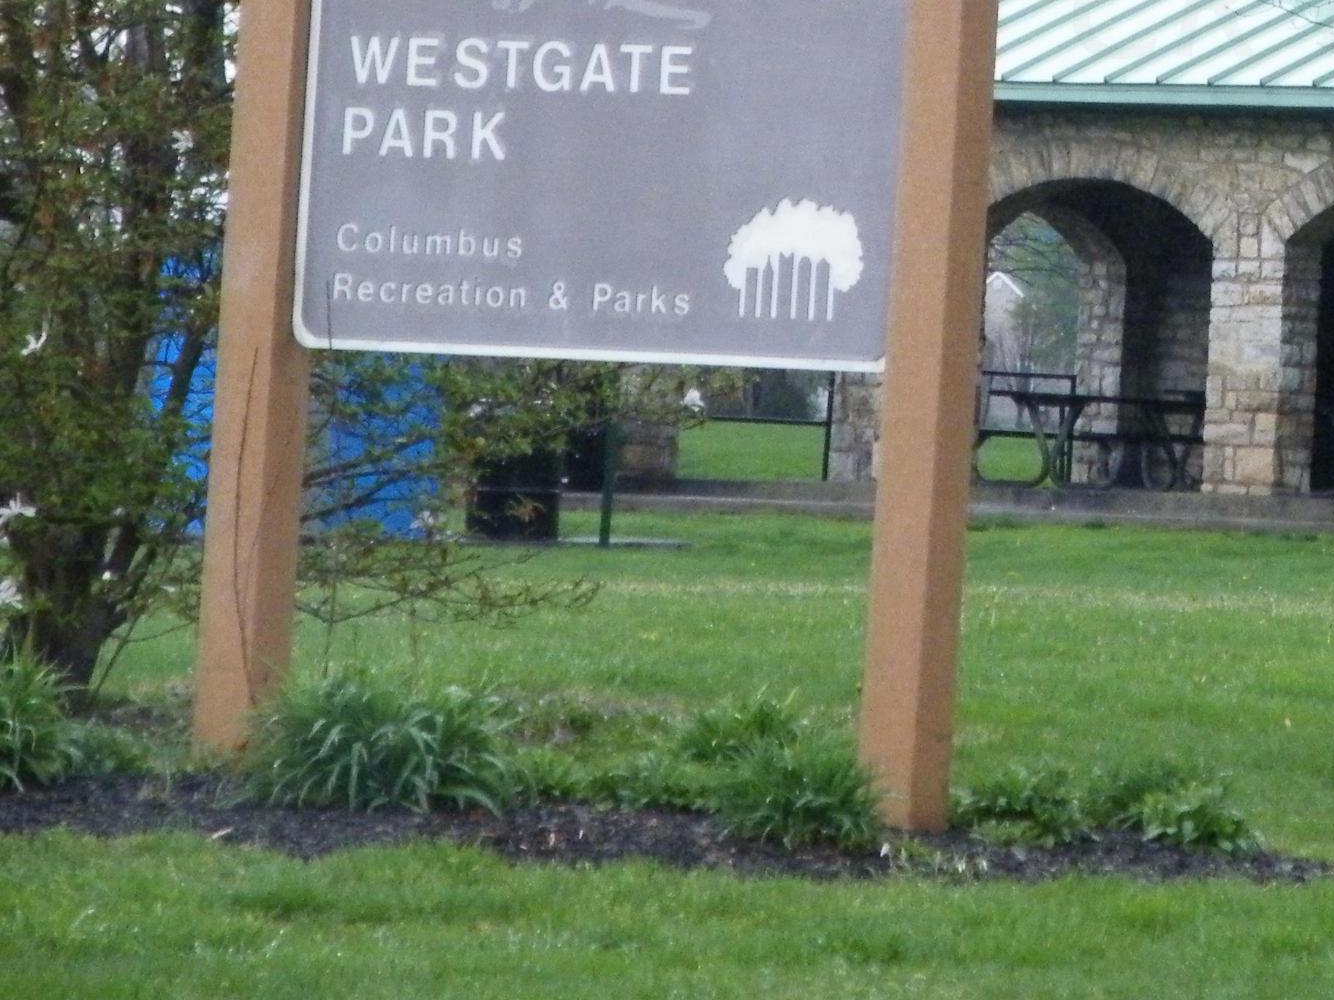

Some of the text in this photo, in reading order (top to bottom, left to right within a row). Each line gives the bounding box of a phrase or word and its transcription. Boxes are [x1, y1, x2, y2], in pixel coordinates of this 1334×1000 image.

[350, 35, 695, 96] WESTGATE
[341, 107, 507, 160] PARK
[336, 223, 524, 258] Columbus
[332, 273, 690, 314] Recreation & Parks
